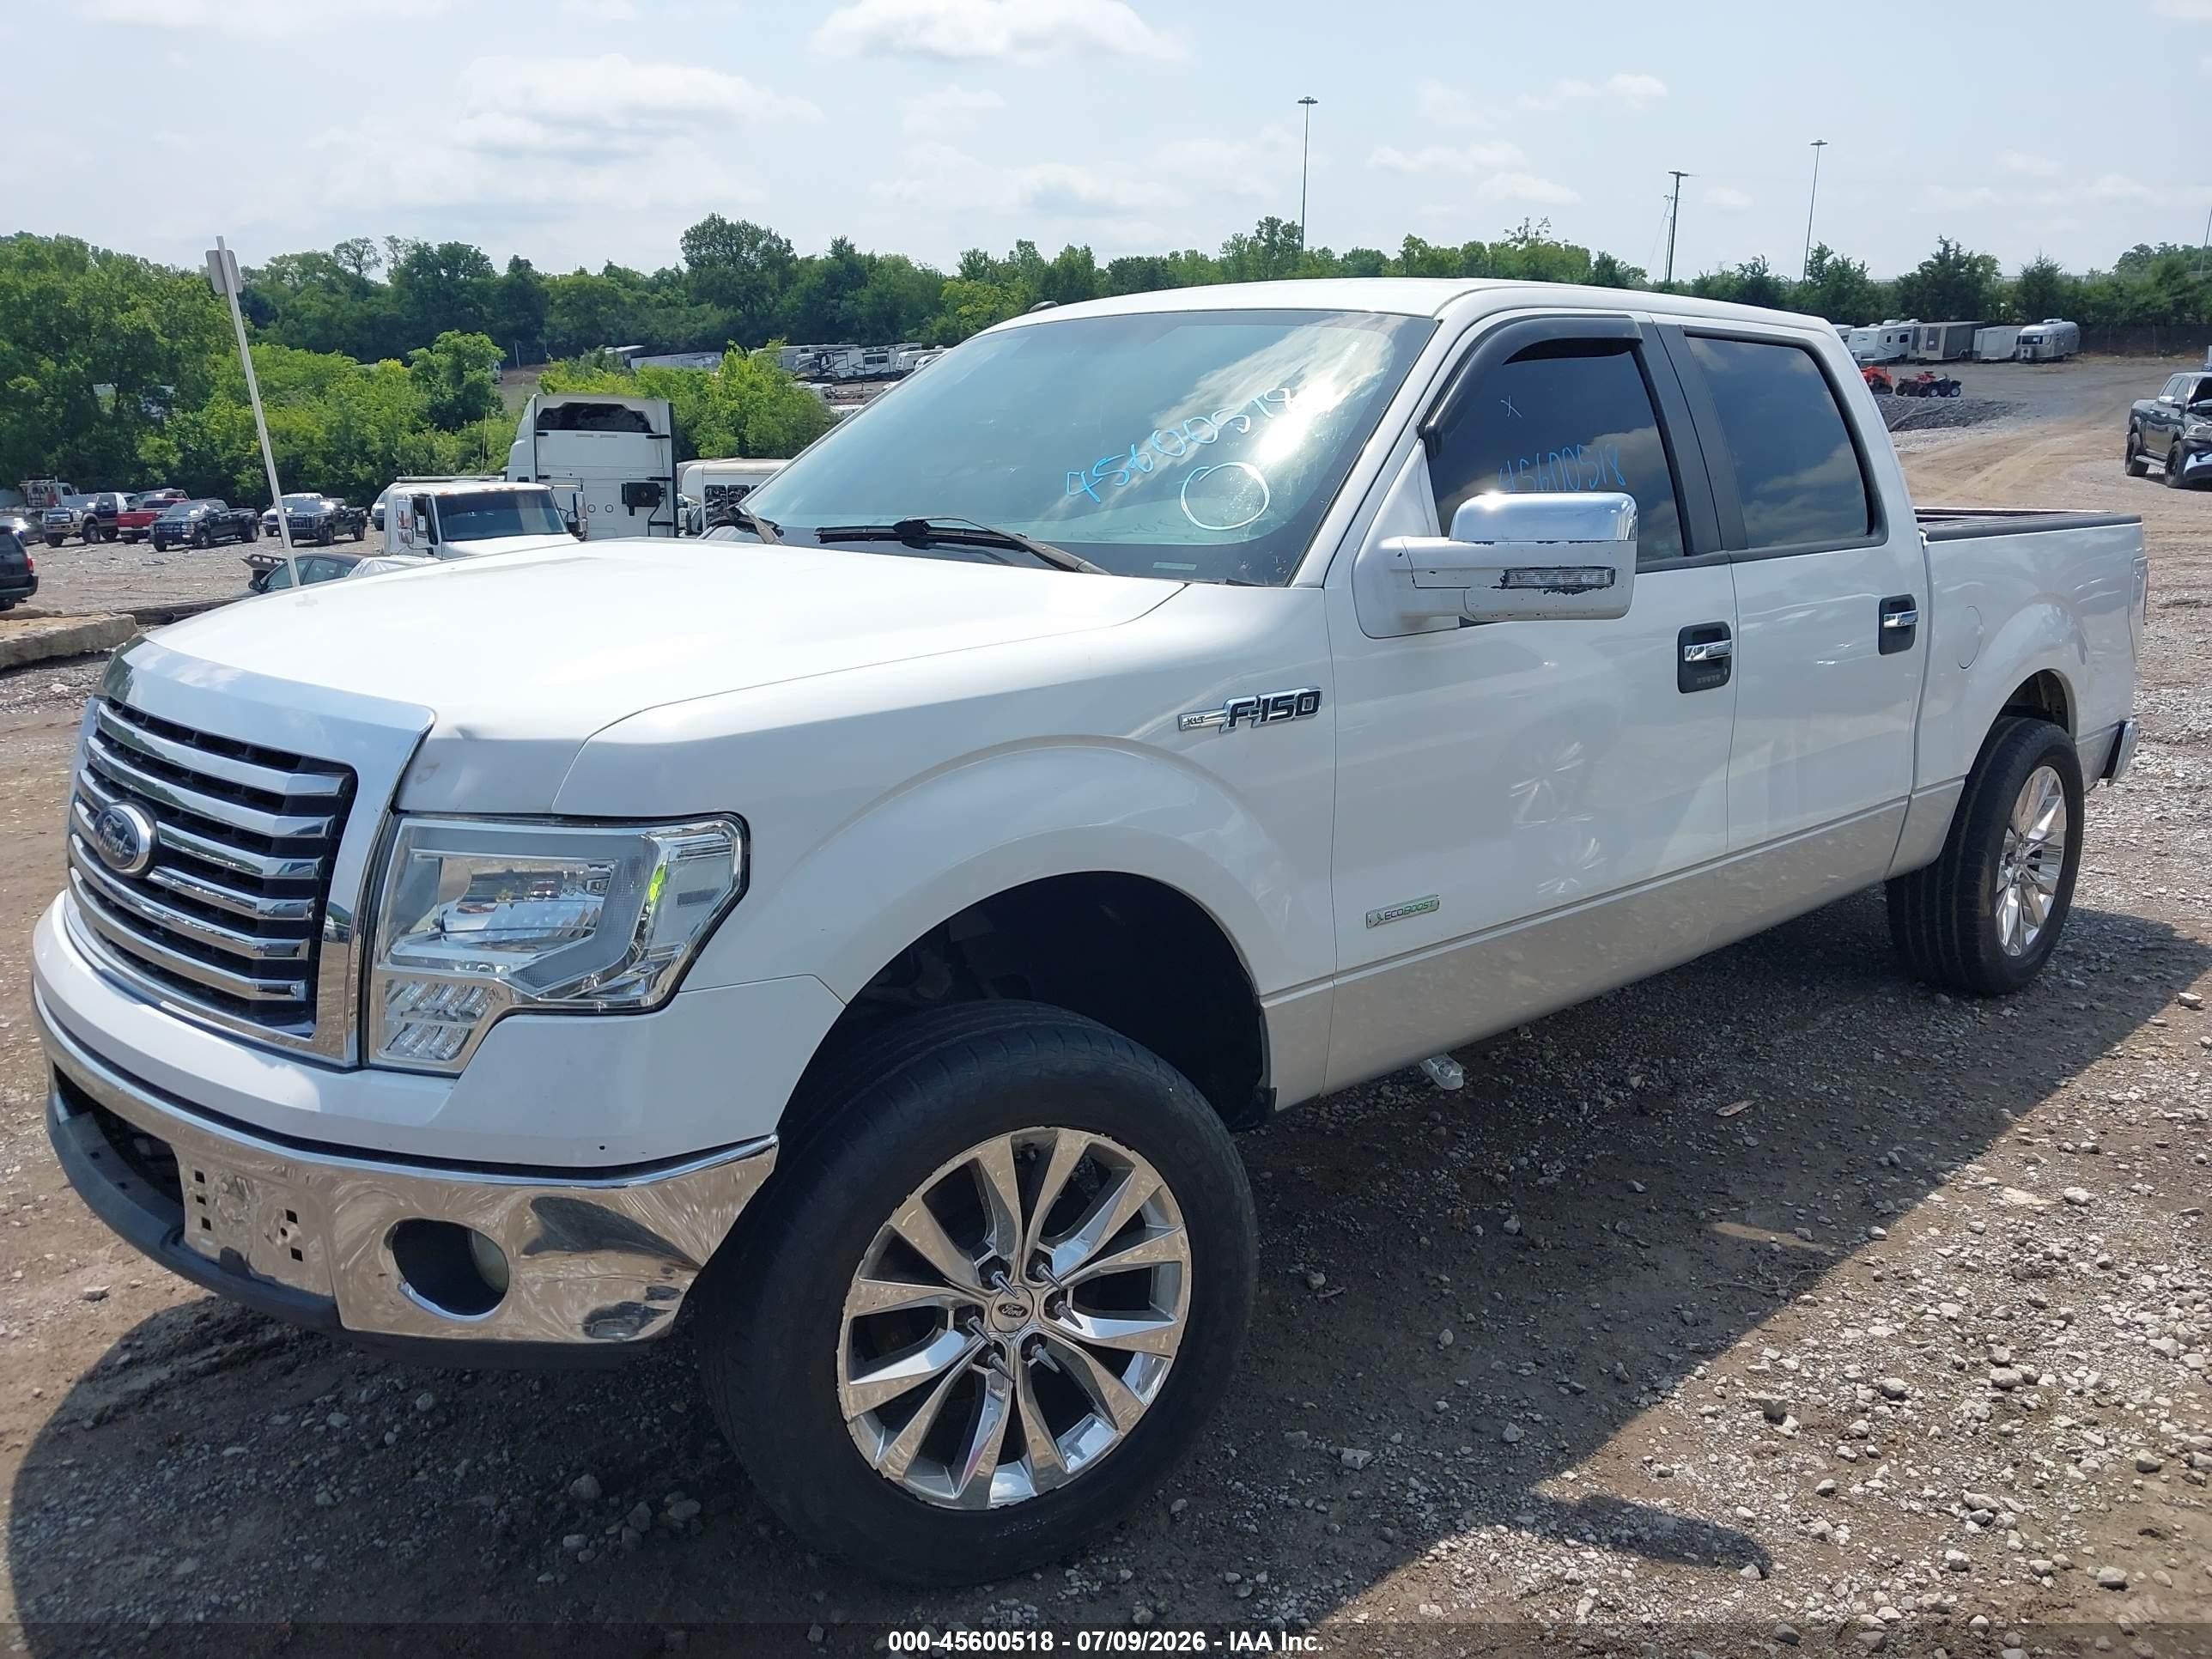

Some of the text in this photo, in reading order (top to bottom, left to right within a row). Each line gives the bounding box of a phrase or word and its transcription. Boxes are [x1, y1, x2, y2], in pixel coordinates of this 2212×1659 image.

[1498, 443, 1627, 493] 45600518
[1222, 687, 1323, 732] F-150
[1384, 899, 1436, 921] ECOBOOST
[1000, 1304, 1025, 1317] Ford
